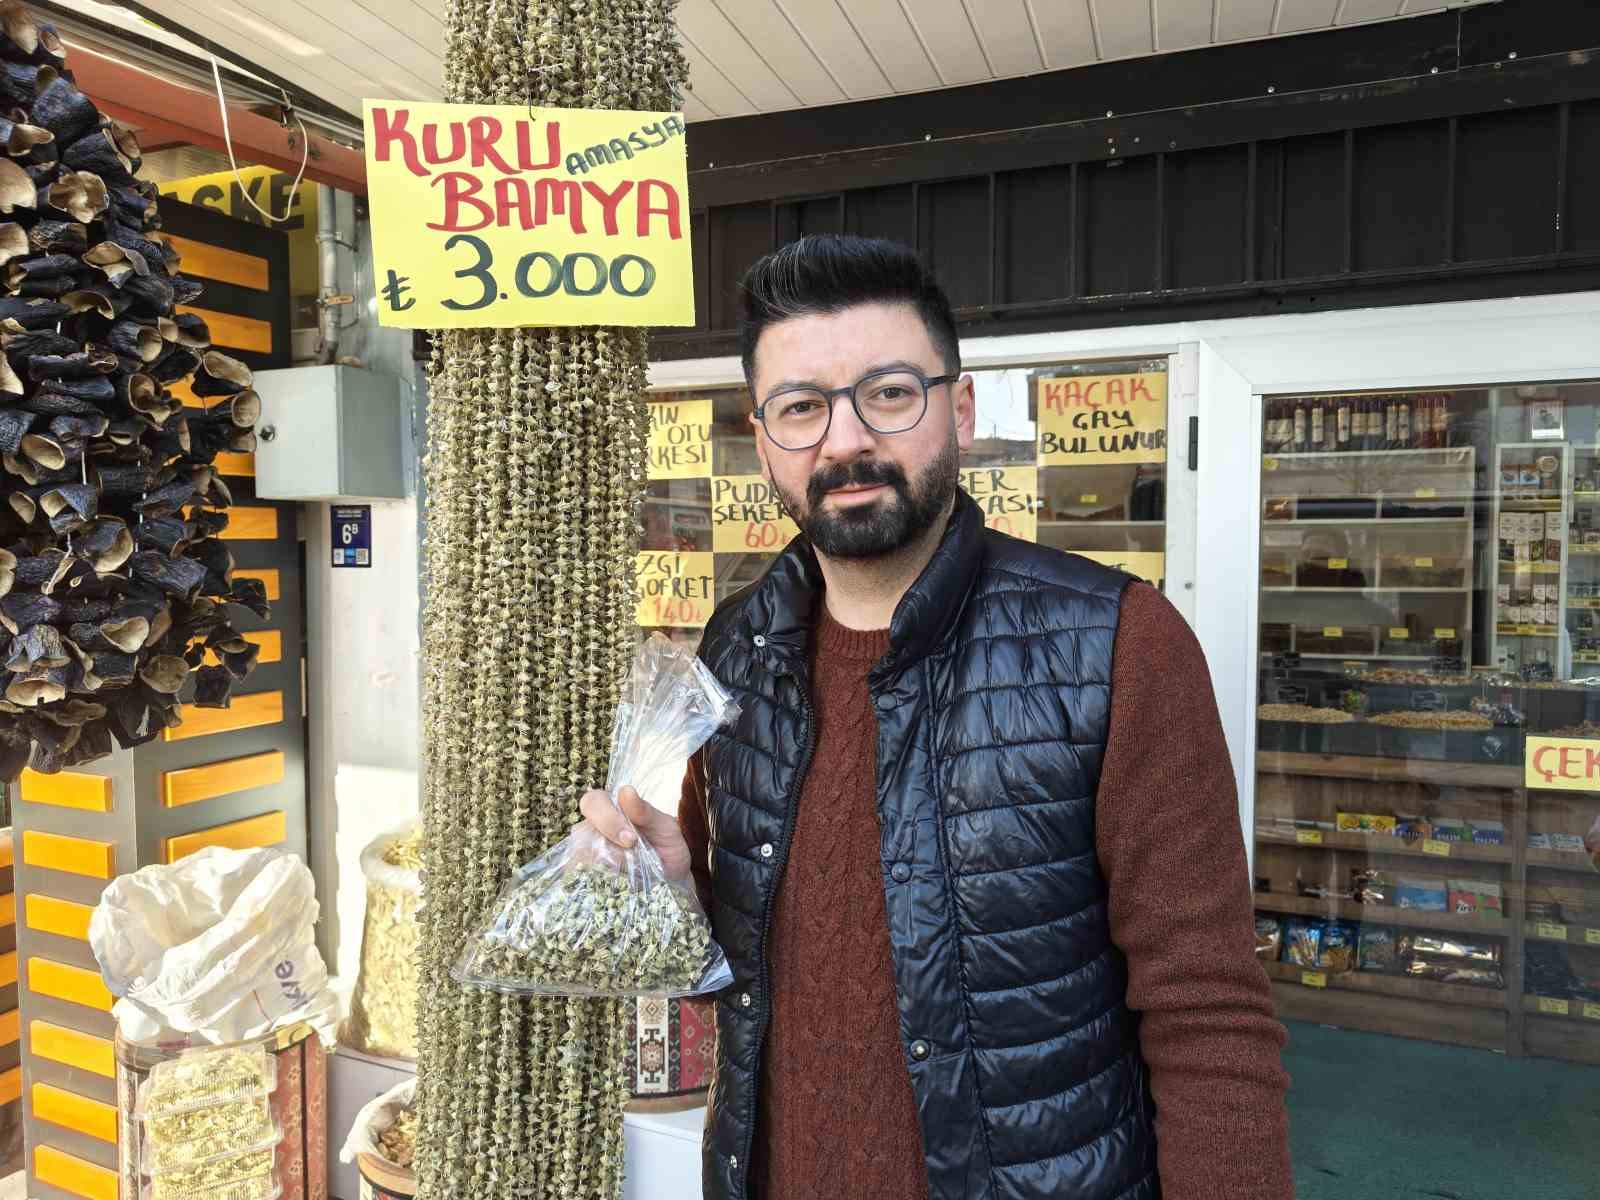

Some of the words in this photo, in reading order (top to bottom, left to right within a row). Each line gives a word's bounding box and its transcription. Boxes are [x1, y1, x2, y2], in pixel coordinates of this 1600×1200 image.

[372, 108, 561, 176] KURU
[565, 115, 687, 175] AMASYA
[163, 173, 305, 230] SKE
[426, 172, 682, 240] BAMYA
[441, 234, 656, 311] 3.000
[1045, 378, 1161, 416] KAÇAK
[1040, 429, 1166, 454] BULUNUR
[977, 493, 1034, 515] ASI
